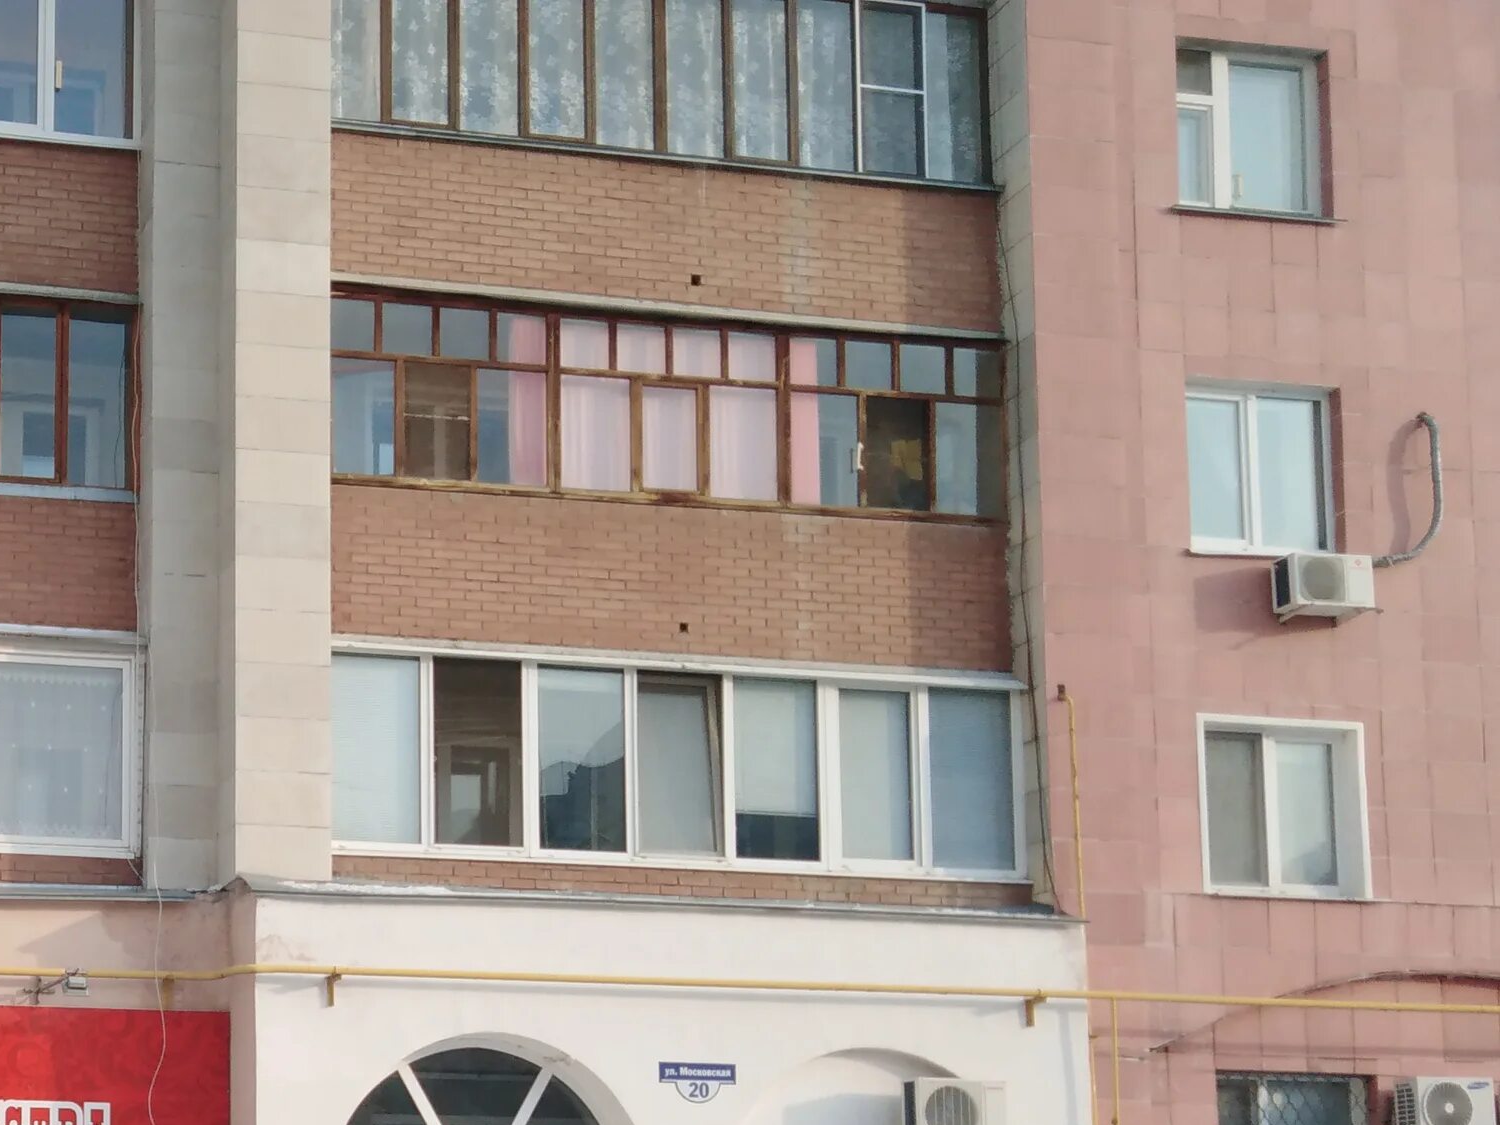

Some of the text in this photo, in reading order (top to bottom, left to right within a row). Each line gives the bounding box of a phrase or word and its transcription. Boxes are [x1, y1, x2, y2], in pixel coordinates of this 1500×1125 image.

[664, 1066, 732, 1078] ул. Московская
[688, 1082, 710, 1099] 20
